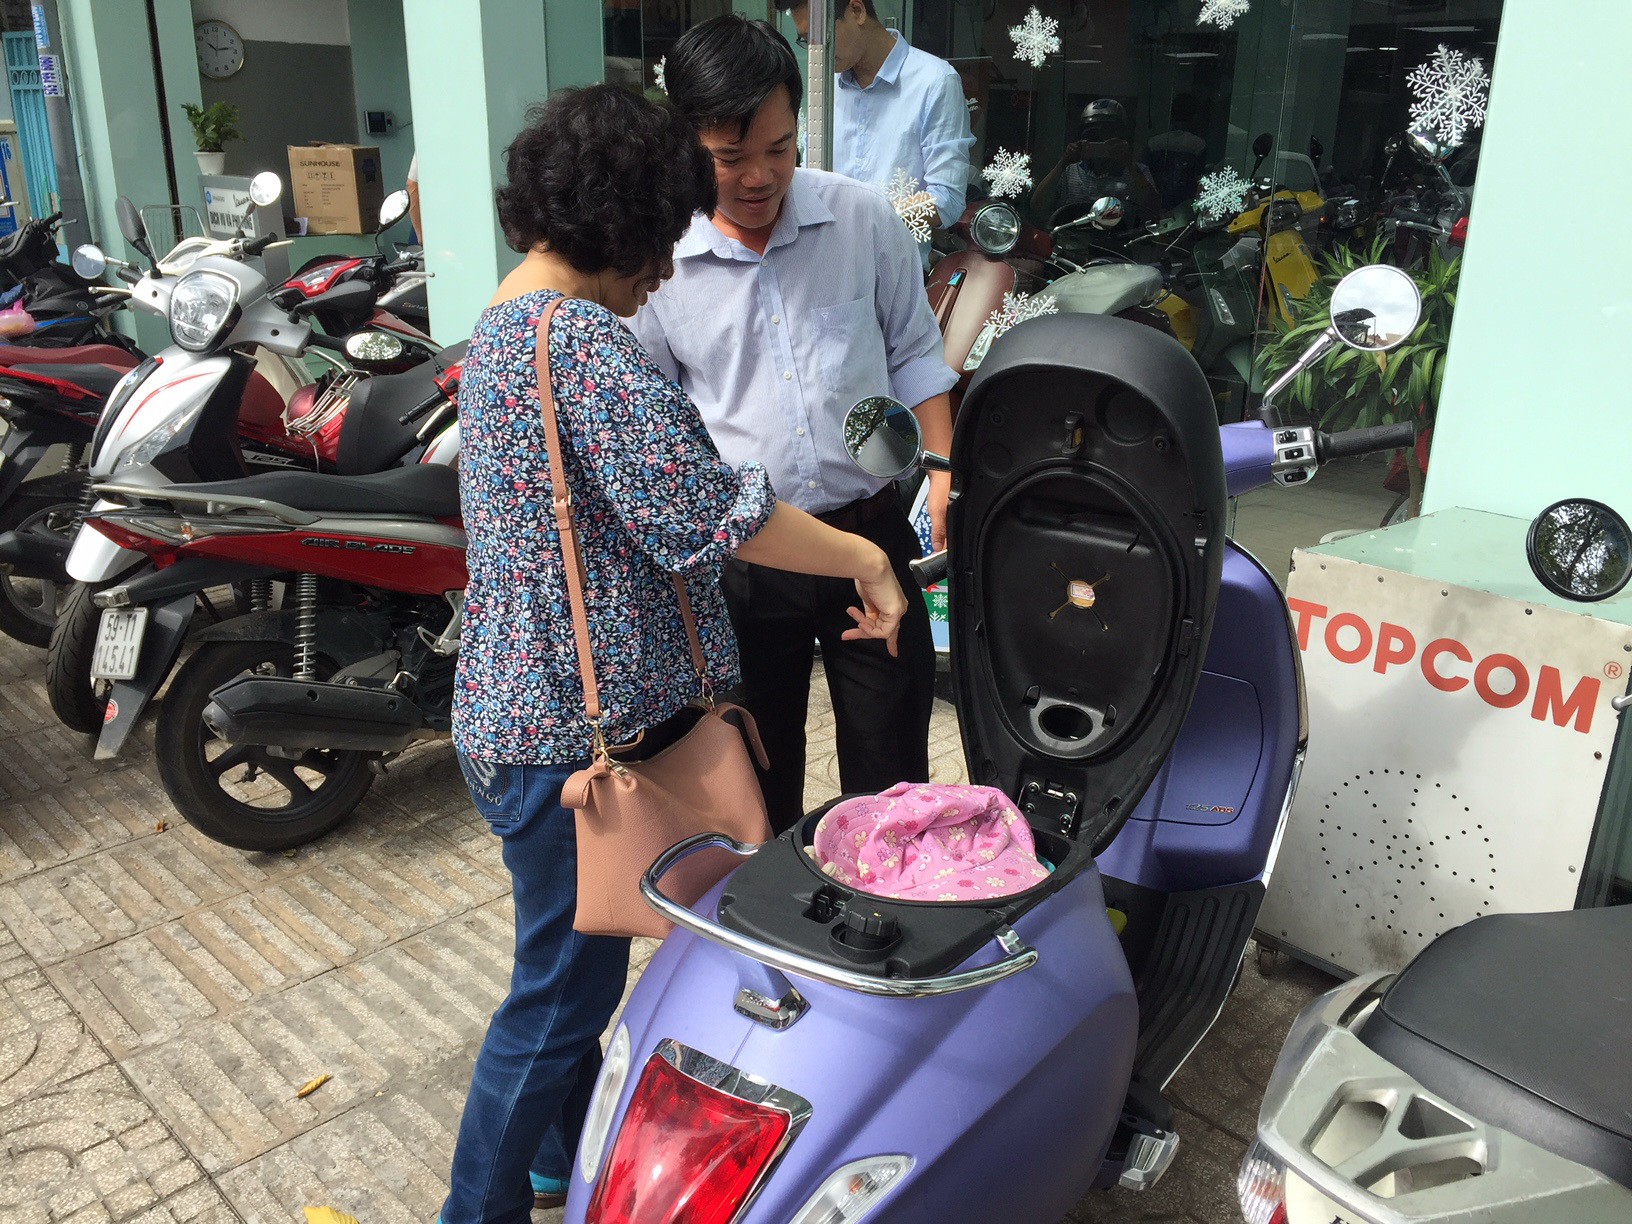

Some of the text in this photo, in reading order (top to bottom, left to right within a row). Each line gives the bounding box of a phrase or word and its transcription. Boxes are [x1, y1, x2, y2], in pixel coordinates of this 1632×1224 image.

[301, 537, 416, 555] AIR BLADE
[1287, 596, 1602, 735] TOPCOM
[1210, 805, 1235, 814] ABS
